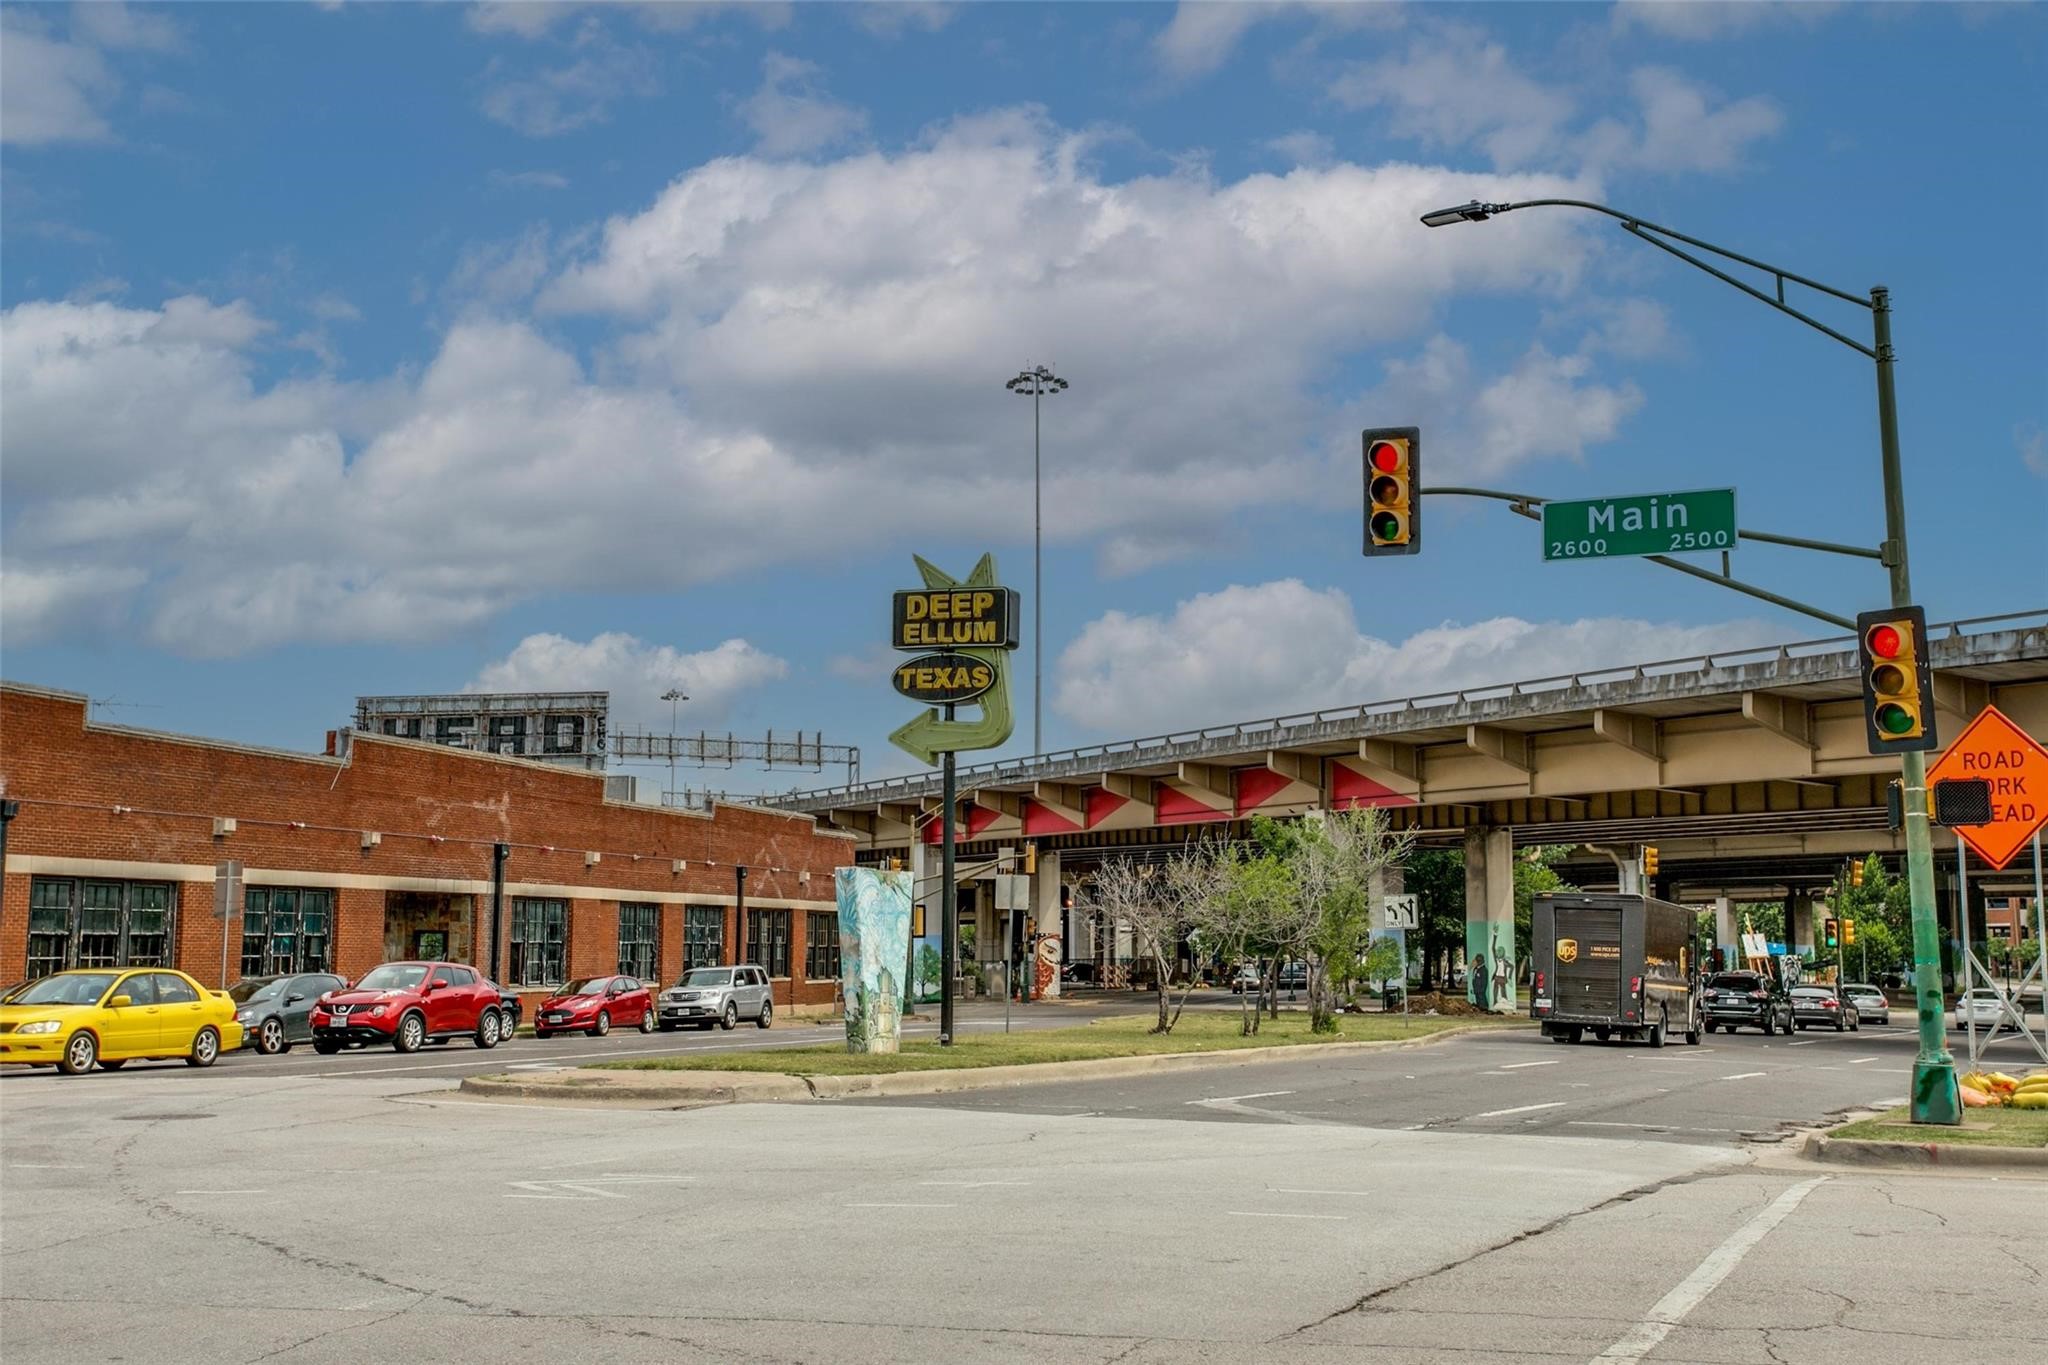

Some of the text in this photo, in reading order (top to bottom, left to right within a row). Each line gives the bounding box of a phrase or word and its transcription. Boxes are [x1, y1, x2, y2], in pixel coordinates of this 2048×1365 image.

[1588, 498, 1688, 534] Main
[1552, 530, 1728, 557] 2600 2500
[906, 592, 994, 620] DEEP
[903, 621, 996, 644] ELLUM
[899, 666, 989, 690] TEXAS
[1963, 751, 2024, 770] ROAD
[1989, 777, 2027, 795] RK
[1992, 804, 2035, 822] EAD
